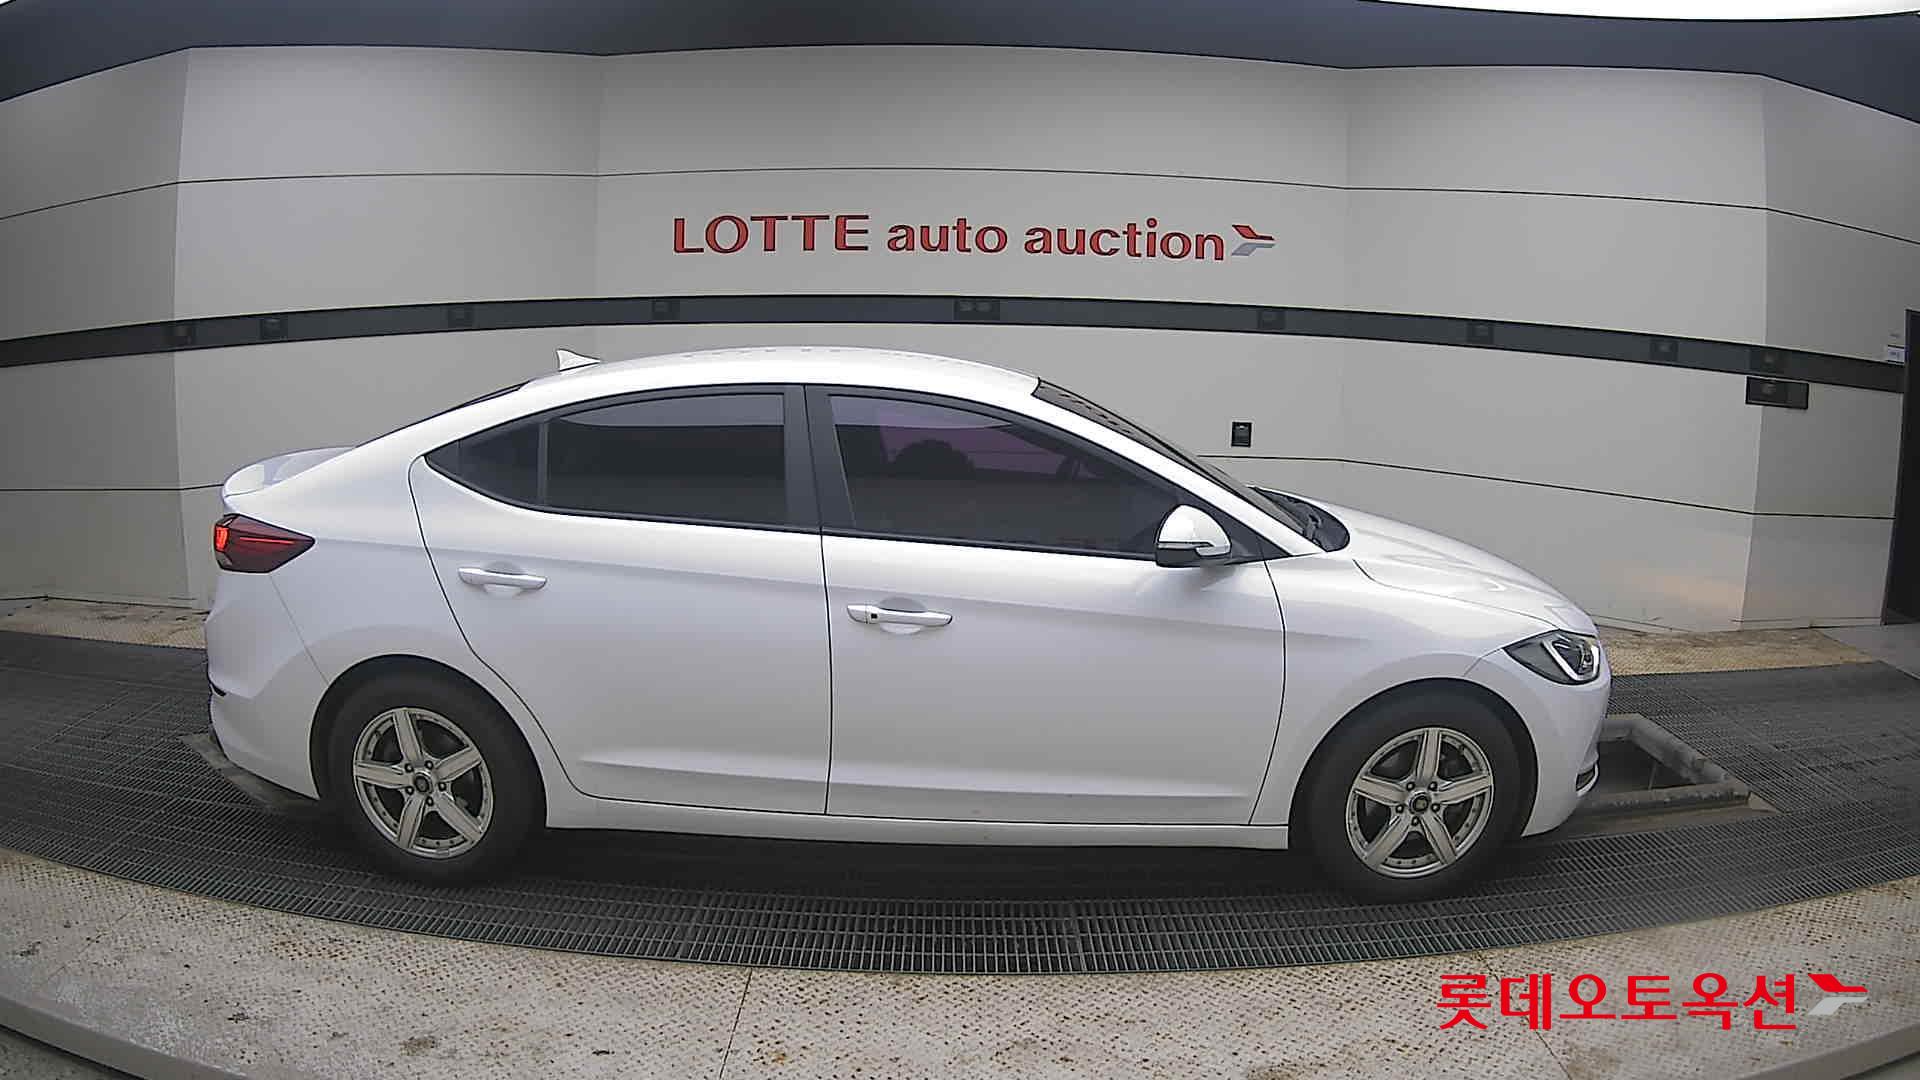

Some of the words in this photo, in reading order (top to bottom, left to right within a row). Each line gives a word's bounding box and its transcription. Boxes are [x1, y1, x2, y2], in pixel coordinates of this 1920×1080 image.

[673, 214, 870, 254] LOTTE
[887, 217, 1009, 255] auto
[1023, 217, 1226, 262] auction
